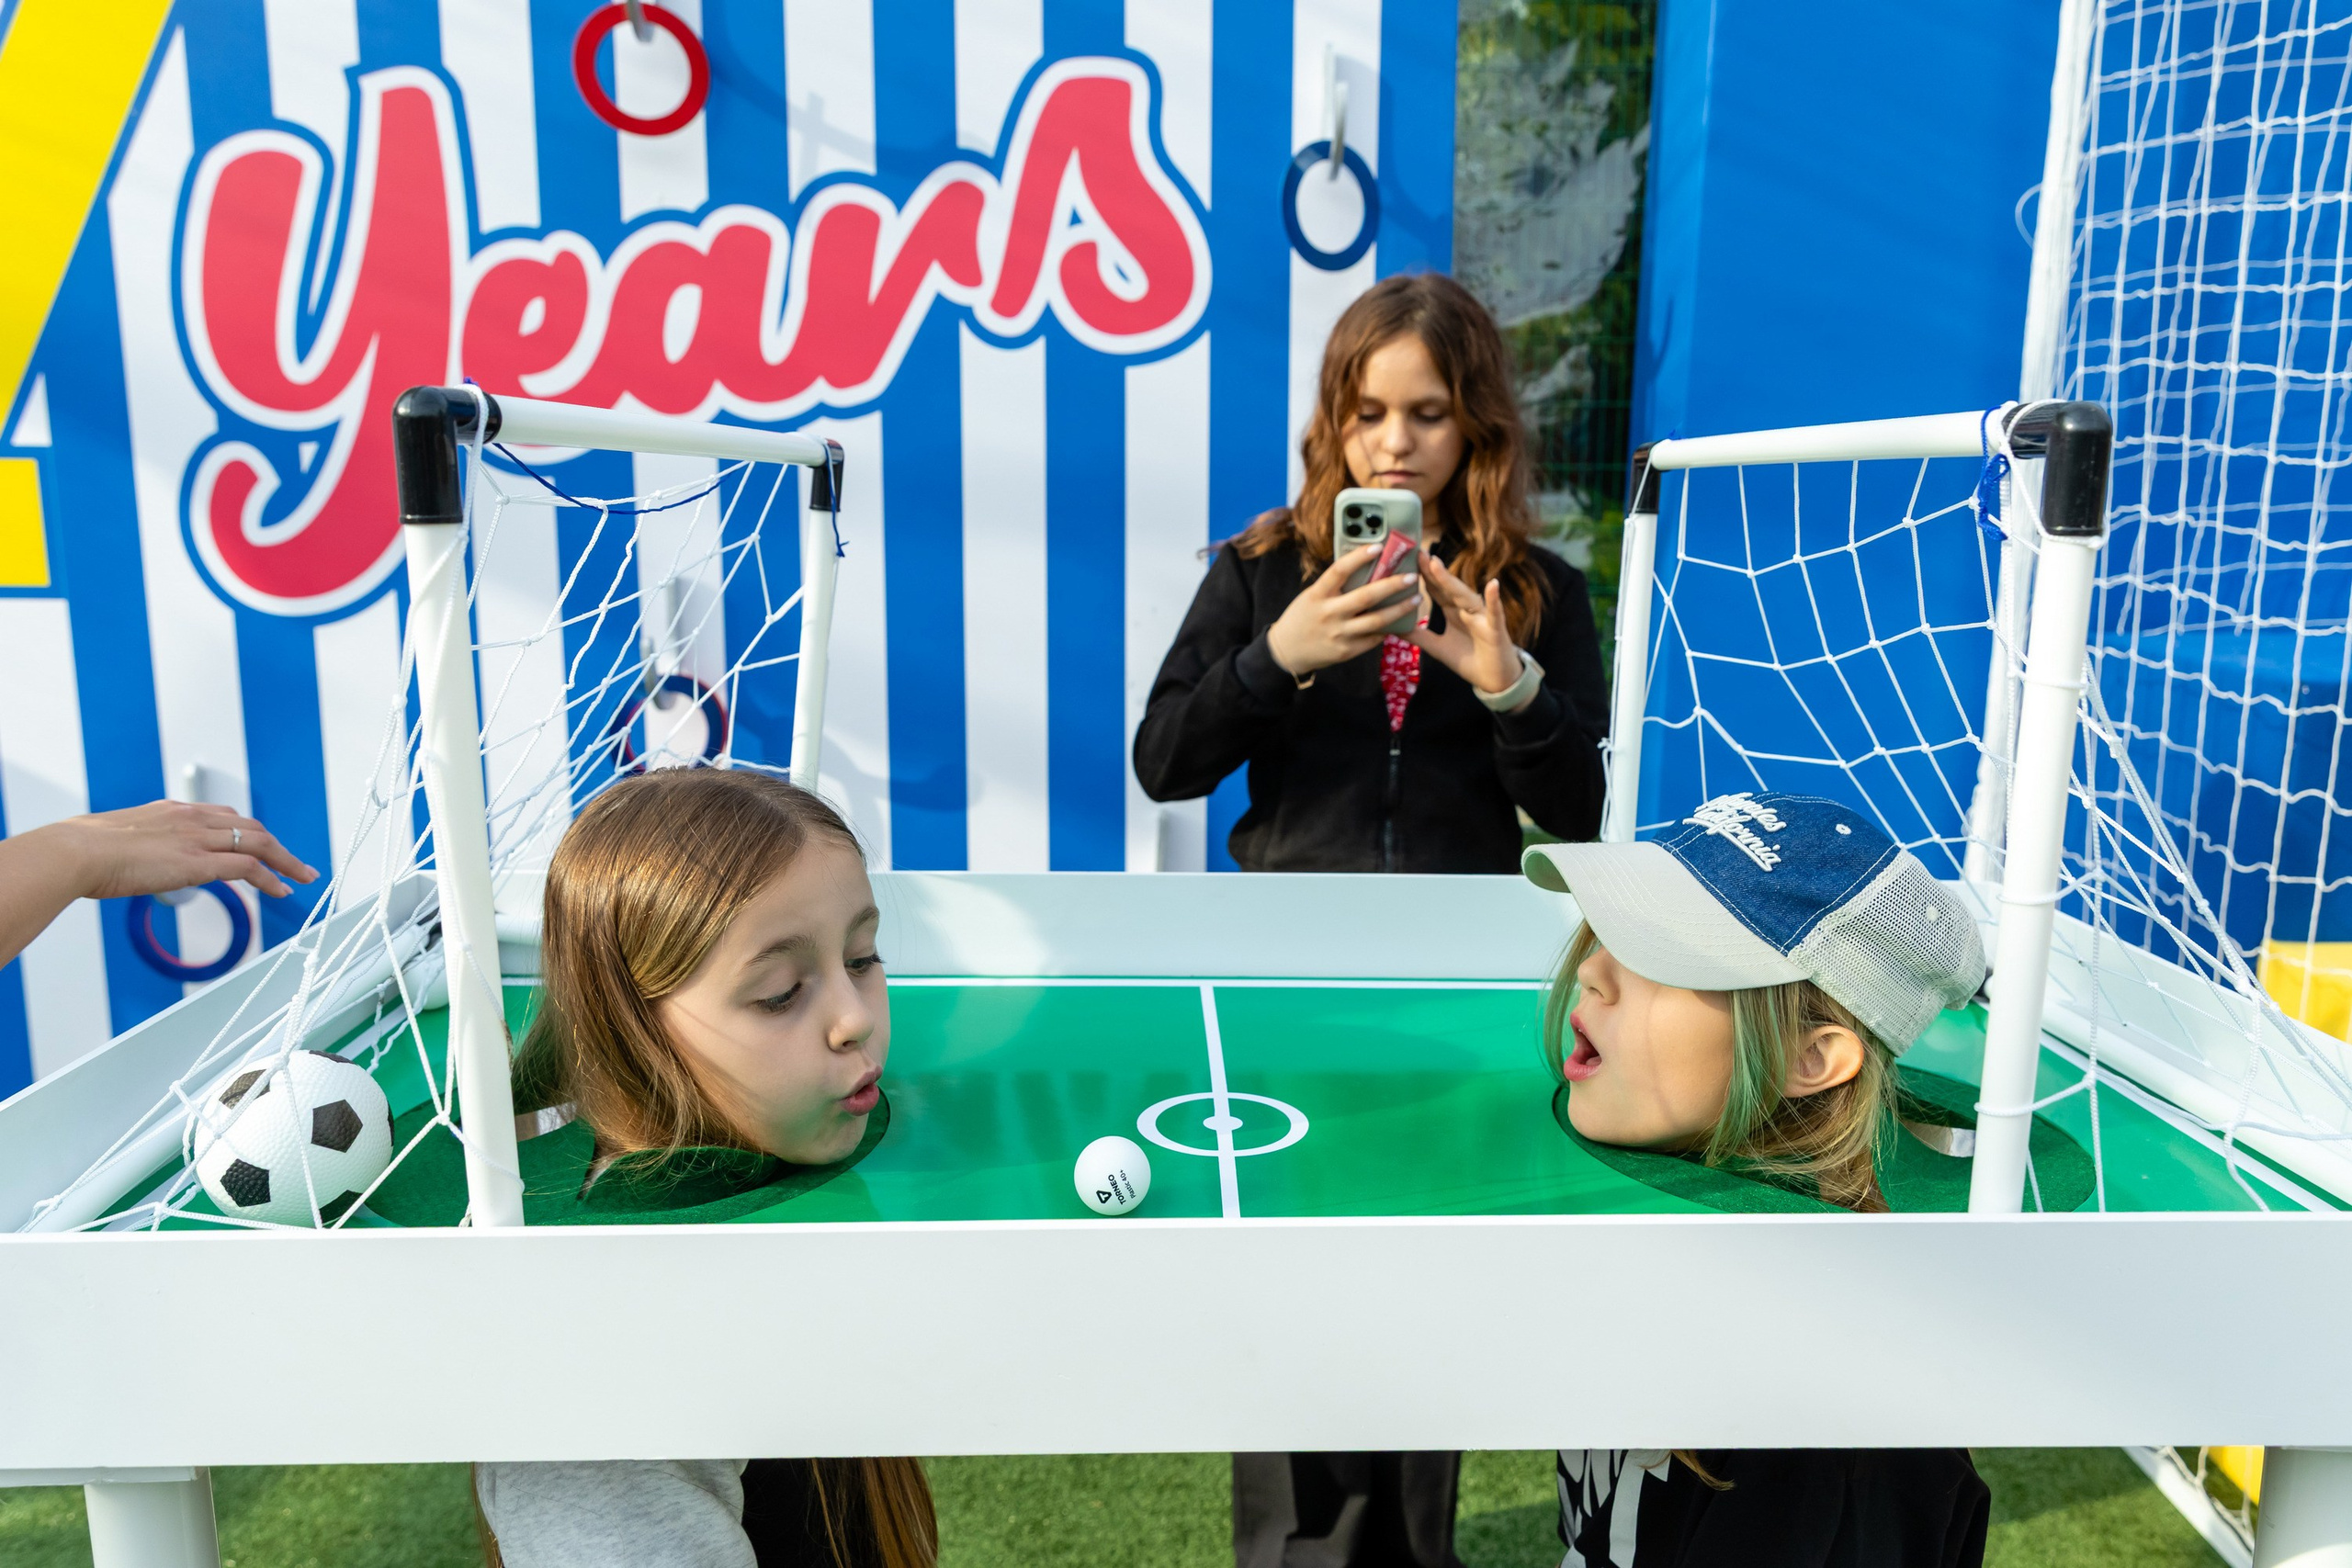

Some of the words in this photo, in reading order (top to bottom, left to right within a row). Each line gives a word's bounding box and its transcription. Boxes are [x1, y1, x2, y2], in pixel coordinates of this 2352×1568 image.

[201, 75, 1196, 599] Years
[1108, 1174, 1126, 1205] TORNEO
[1125, 1180, 1136, 1199] Plastic
